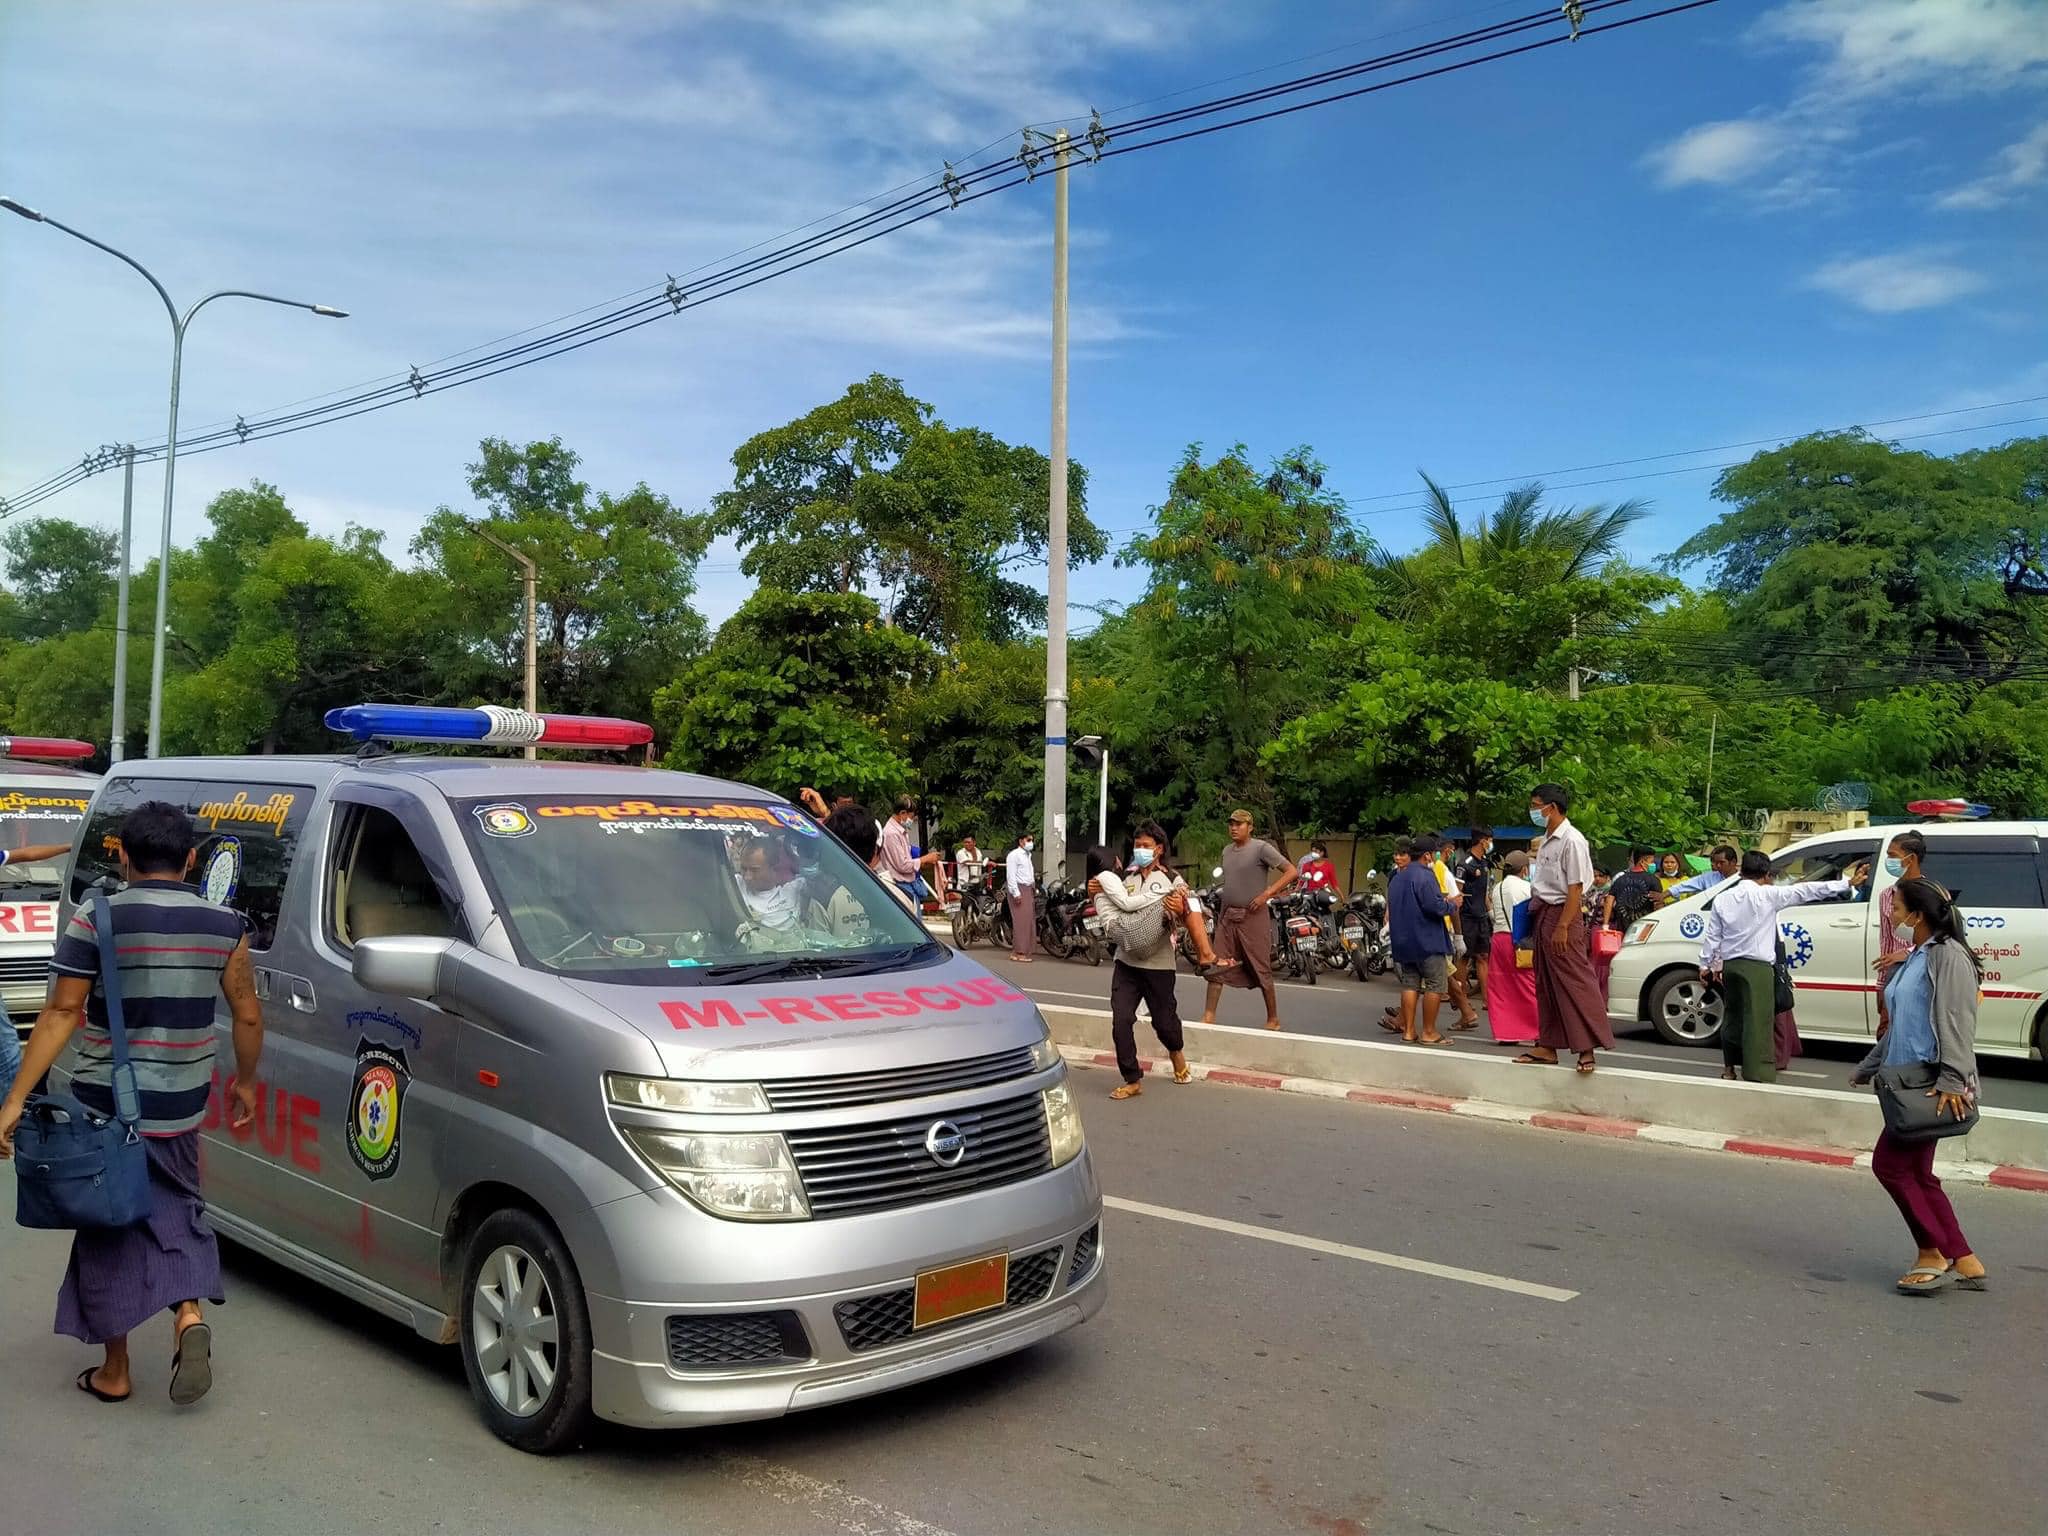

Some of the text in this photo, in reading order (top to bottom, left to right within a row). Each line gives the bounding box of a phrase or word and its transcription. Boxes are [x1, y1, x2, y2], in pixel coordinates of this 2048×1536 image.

[0, 905, 55, 933] RE
[659, 977, 1026, 1030] M-RESCUE
[202, 1065, 321, 1174] SCUE
